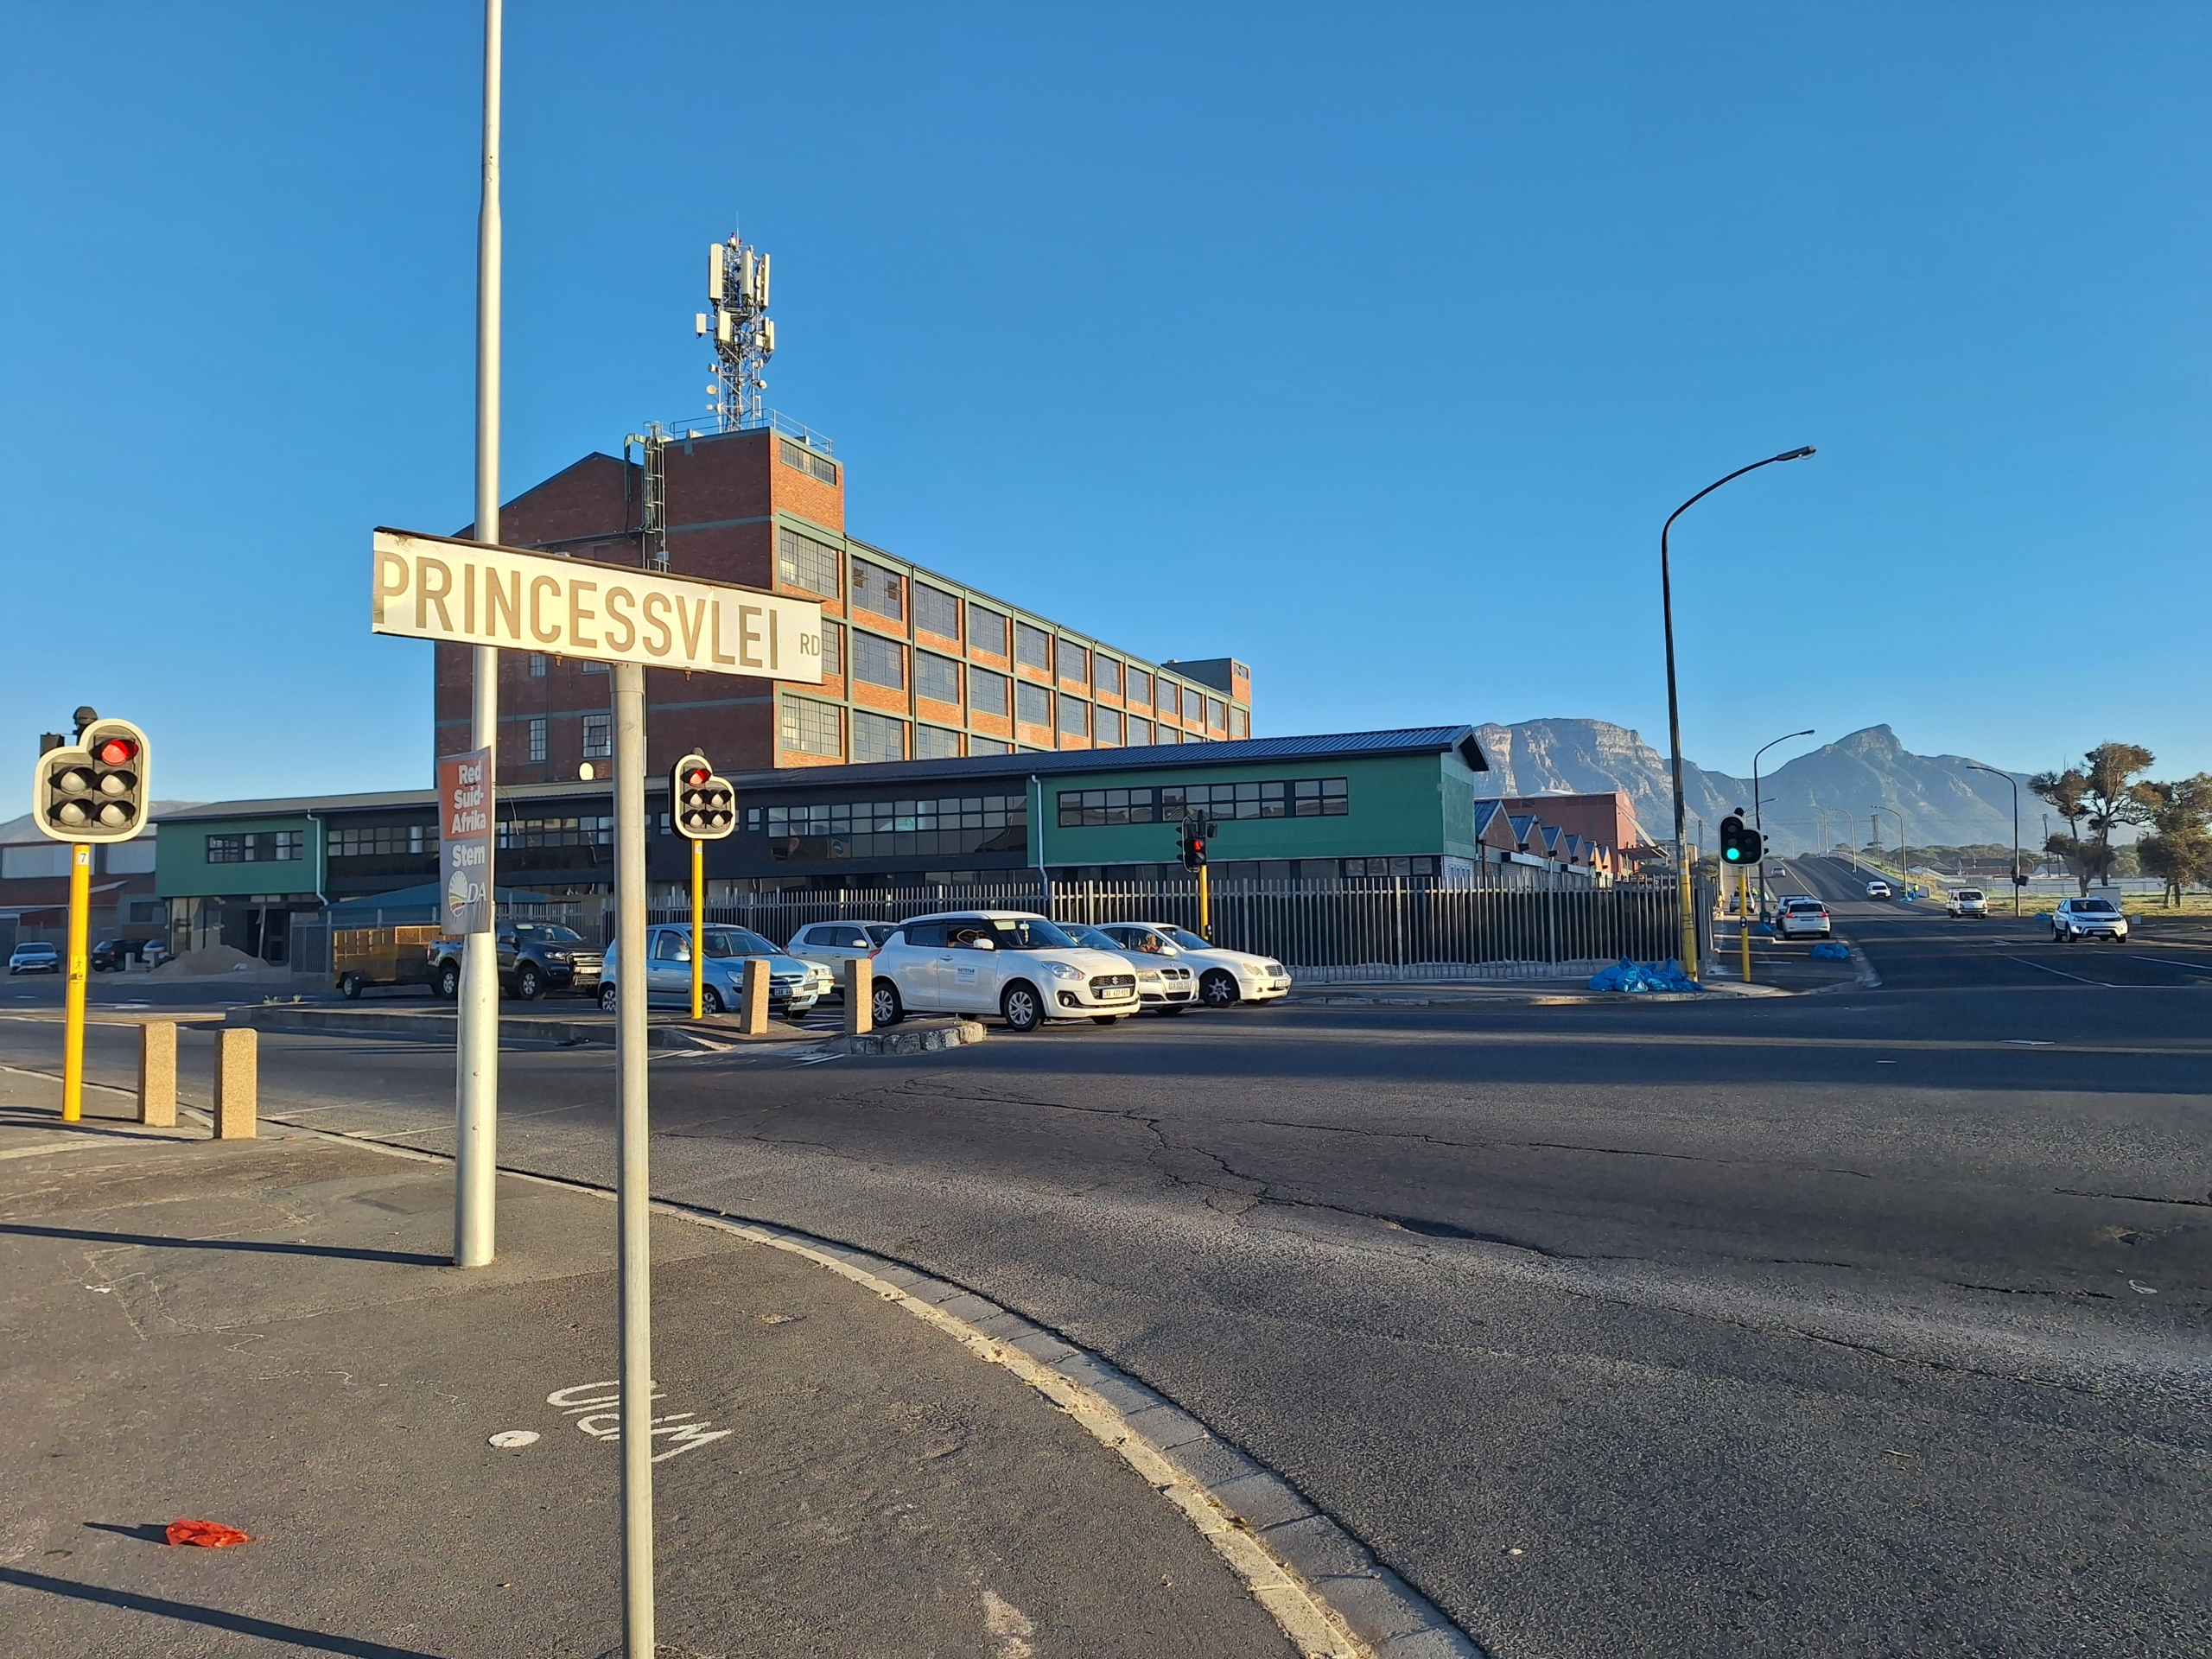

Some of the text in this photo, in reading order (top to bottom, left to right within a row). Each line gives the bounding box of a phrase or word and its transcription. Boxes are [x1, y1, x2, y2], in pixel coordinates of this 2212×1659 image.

[372, 550, 821, 670] PRINCESSVLEI RD
[458, 762, 481, 785] Red
[454, 785, 484, 810] Suid-
[451, 810, 486, 835] Afrika
[79, 853, 87, 863] 7
[452, 844, 486, 868] Stem
[467, 881, 487, 903] DA
